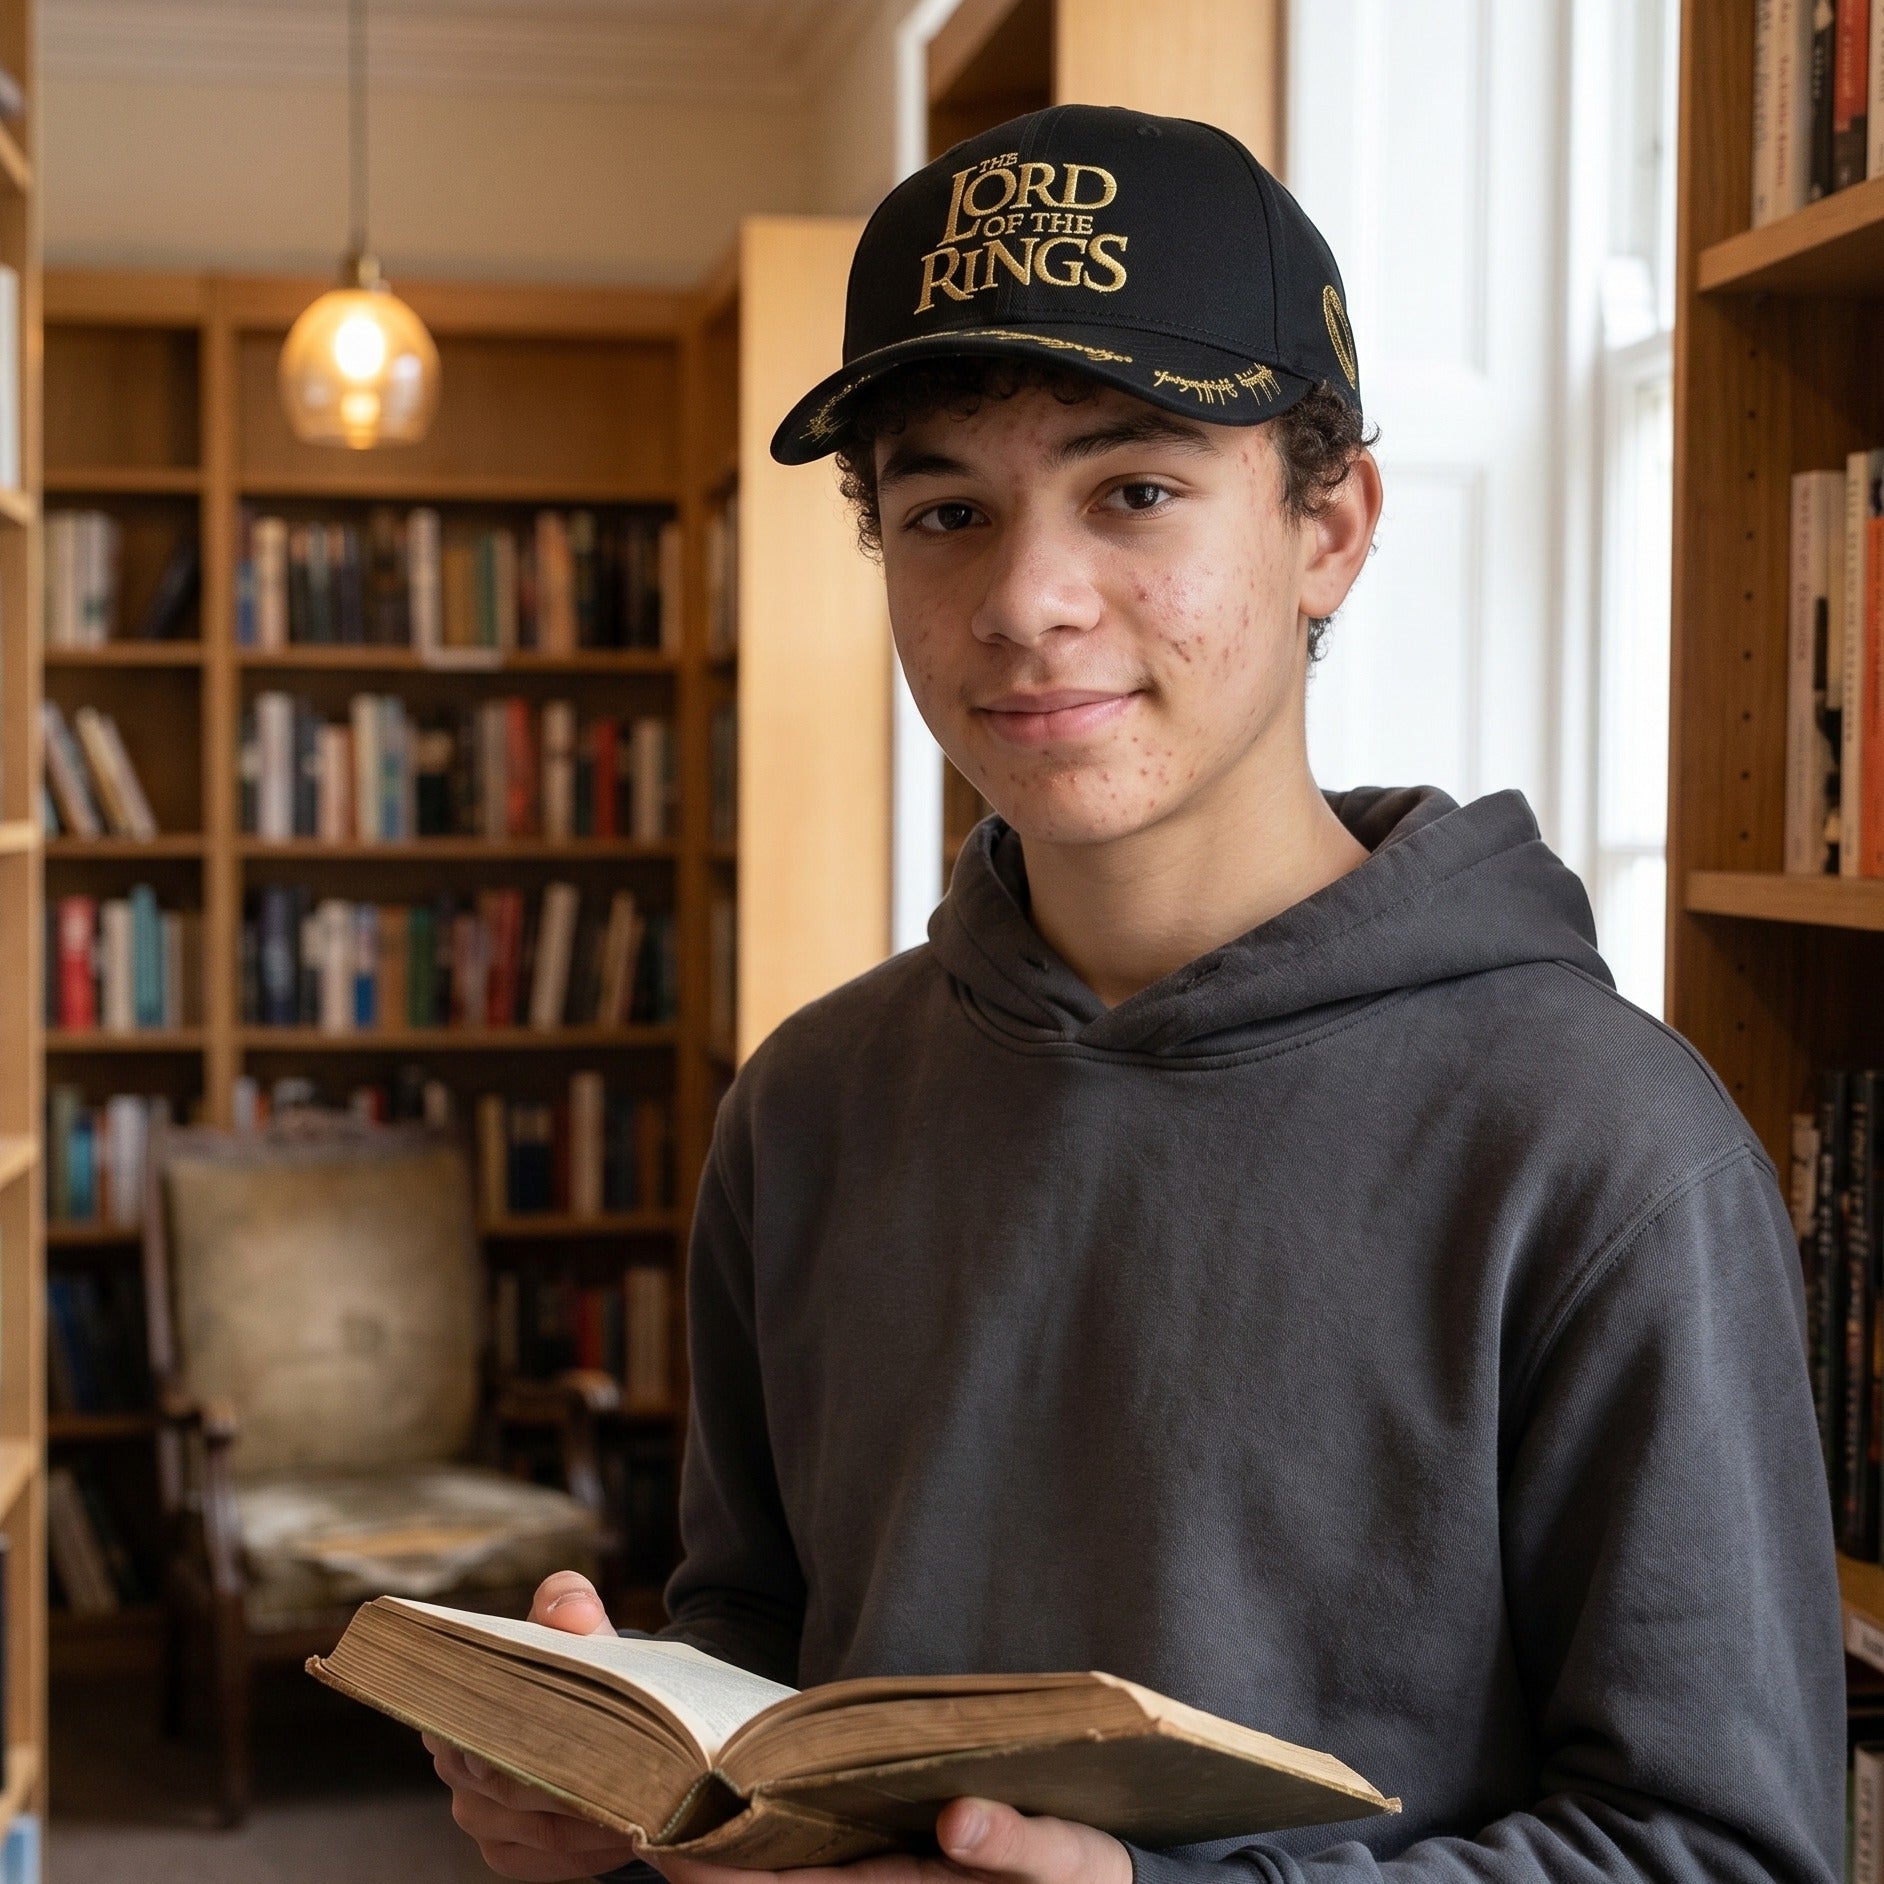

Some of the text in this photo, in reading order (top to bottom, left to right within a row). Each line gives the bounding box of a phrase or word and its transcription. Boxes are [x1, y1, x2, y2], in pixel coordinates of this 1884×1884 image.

[979, 152, 1019, 174] THE
[936, 162, 1118, 248] LORD
[983, 212, 1094, 237] OF THE
[913, 233, 1129, 316] RINGS
